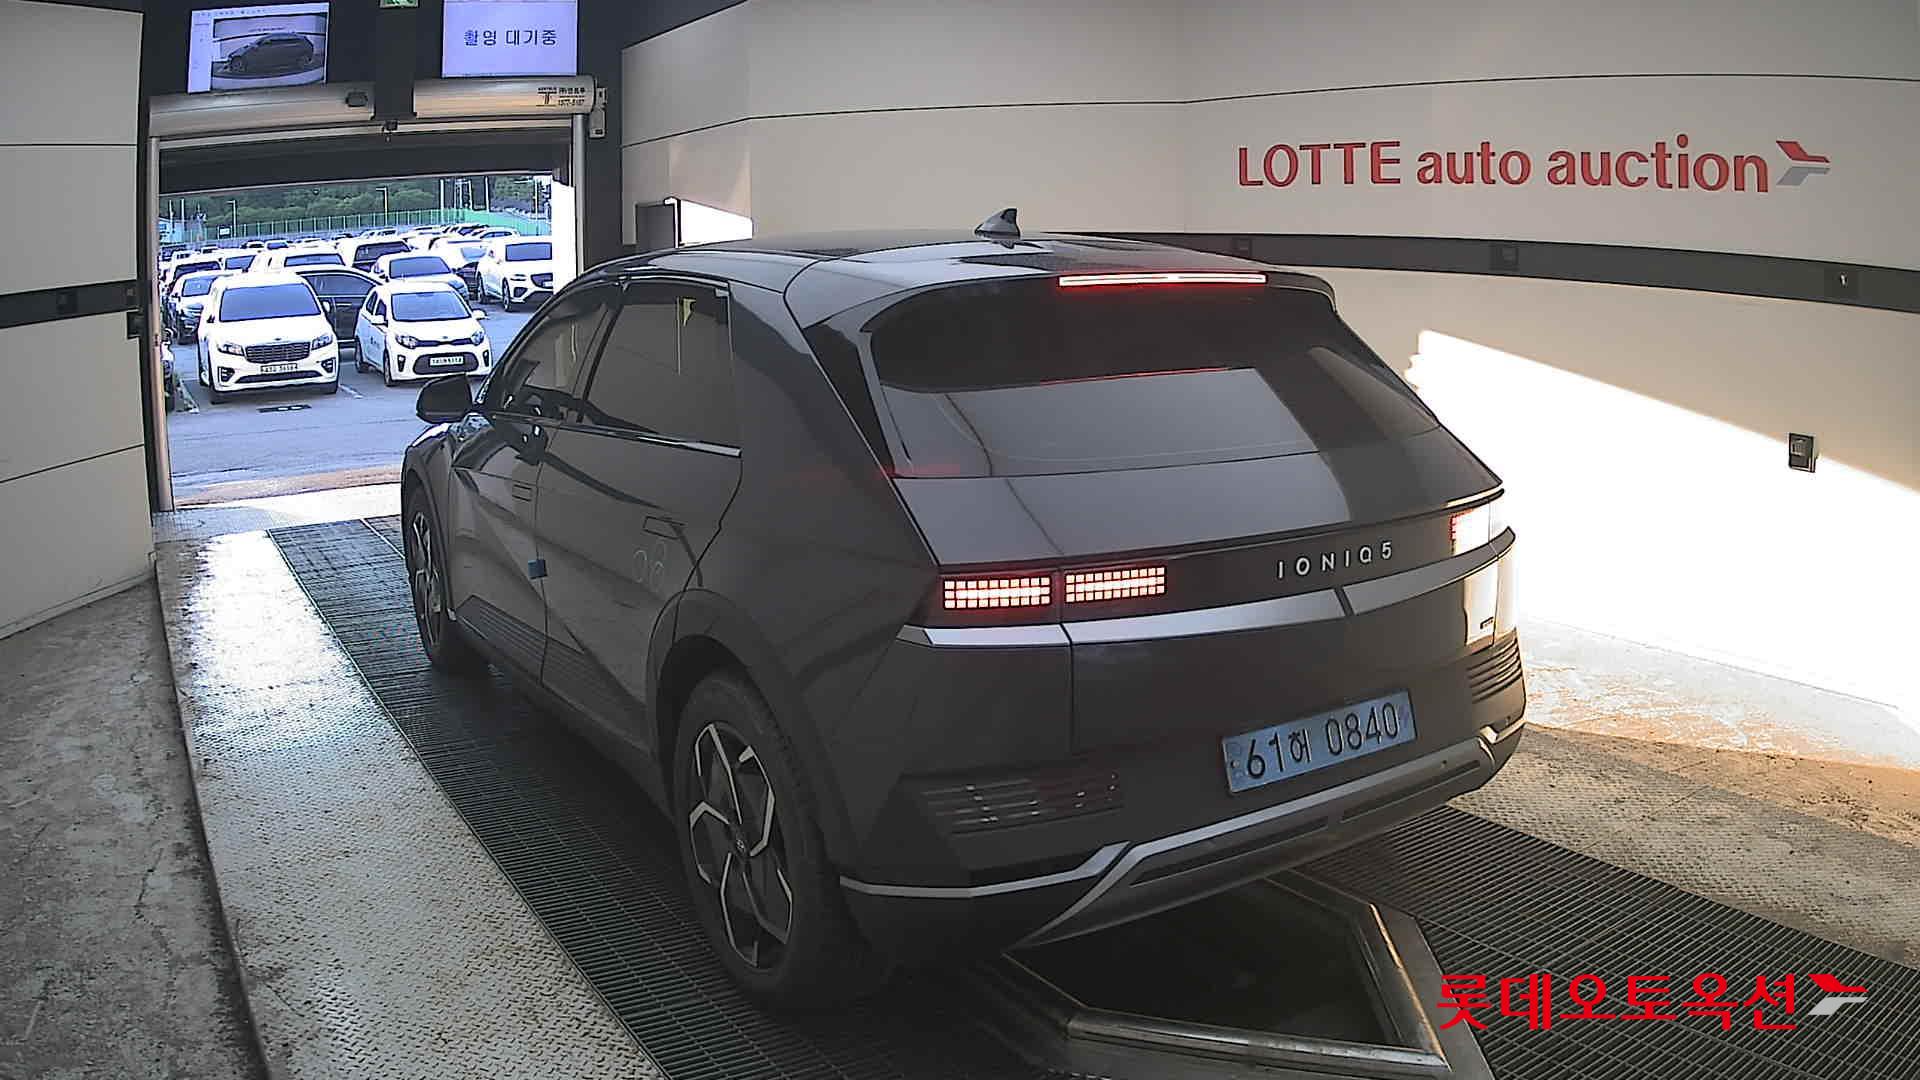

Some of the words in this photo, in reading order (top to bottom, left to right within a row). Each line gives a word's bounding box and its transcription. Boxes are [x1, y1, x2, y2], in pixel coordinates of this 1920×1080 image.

[505, 29, 557, 46] 대기중
[1238, 140, 1401, 187] LOTTE
[1416, 141, 1532, 186] auto
[1547, 134, 1769, 193] auction
[1246, 728, 1312, 780] 61허
[1324, 702, 1399, 757] 0840
